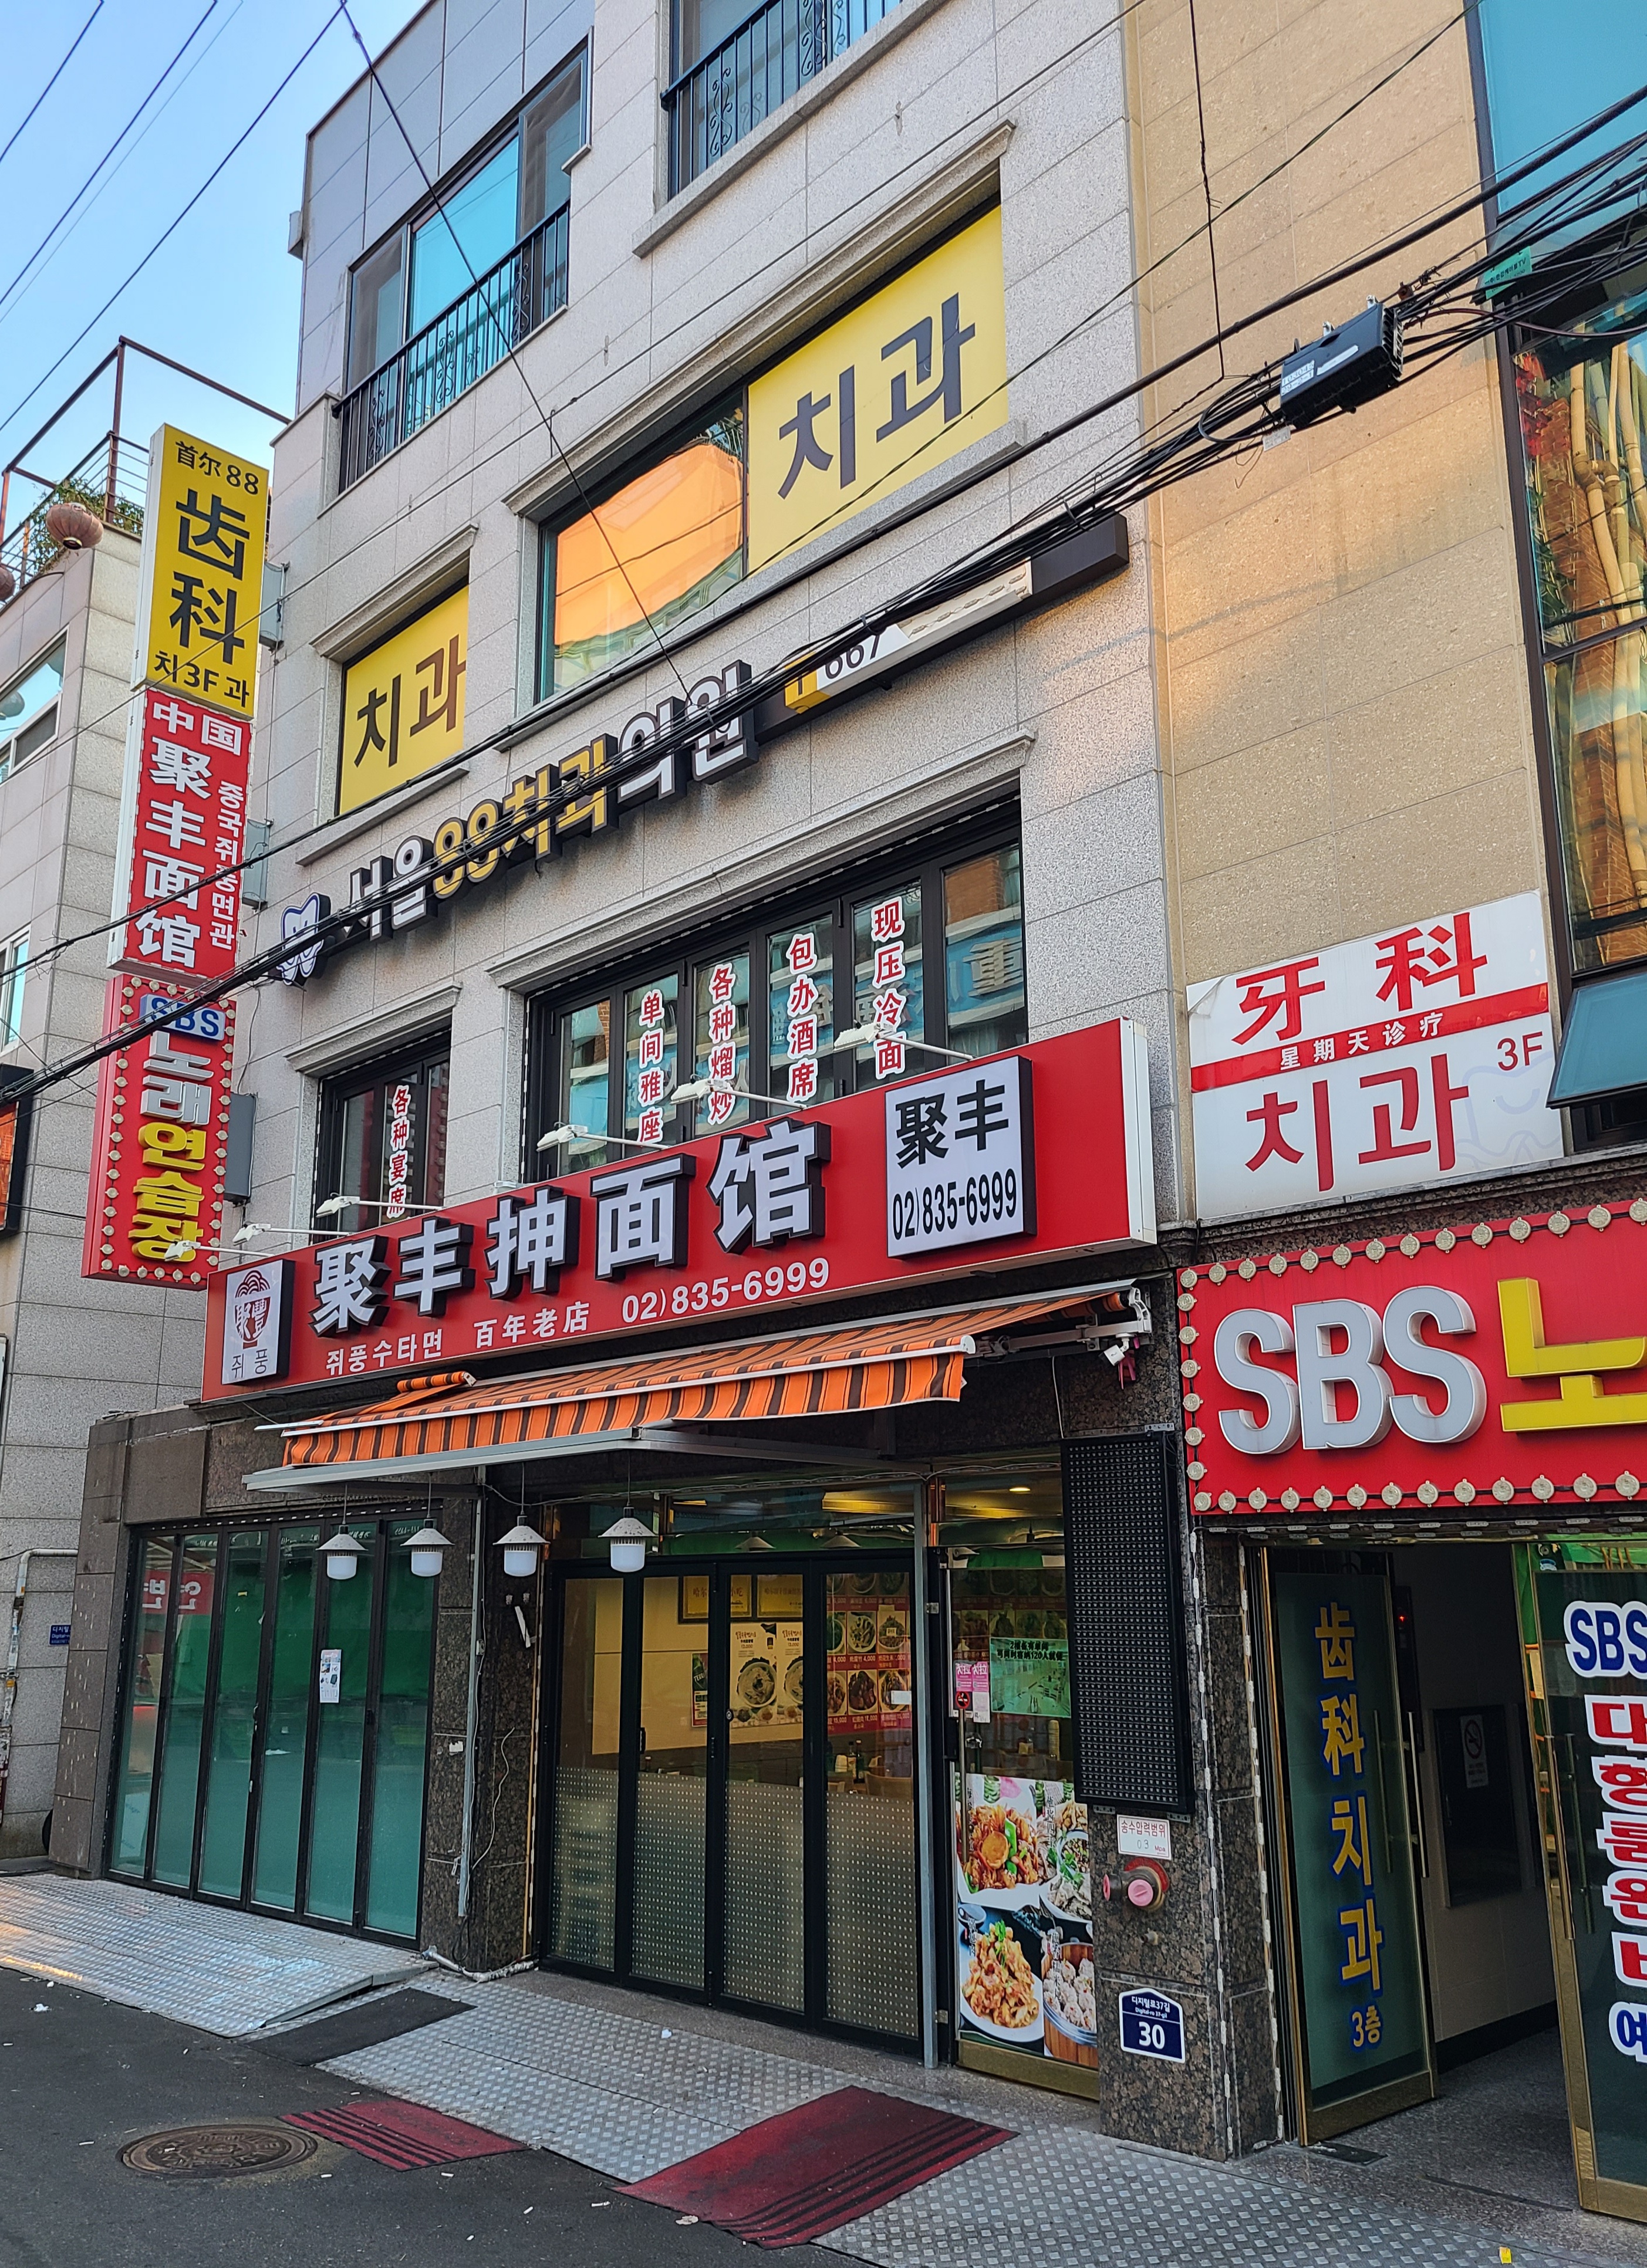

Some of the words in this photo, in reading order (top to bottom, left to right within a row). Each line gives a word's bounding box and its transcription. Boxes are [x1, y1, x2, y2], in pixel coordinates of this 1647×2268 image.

[778, 292, 976, 499] 치과
[169, 488, 251, 665] 齿科
[153, 702, 242, 756] 中国
[354, 634, 466, 768] 치과
[134, 736, 212, 969] 聚丰面馆
[789, 937, 815, 1098] 包办酒席
[873, 900, 905, 1075] 现压冷面
[1231, 911, 1488, 1045] 牙科
[1280, 1012, 1444, 1070] 星期天诊疗
[638, 992, 663, 1143] 单间雅座
[710, 966, 734, 1121] 各种熘炒
[1497, 1031, 1544, 1071] 3F
[129, 1030, 214, 1263] 노래연습장
[389, 1088, 410, 1214] 各种宴席
[895, 1079, 1010, 1169] 聚丰
[1244, 1053, 1469, 1192] 치과
[893, 1168, 1017, 1241] 02)835-6999
[326, 1328, 443, 1377] 쥐풍수타면
[473, 1300, 590, 1349] 百年老店
[622, 1257, 829, 1324] 02)835-6999
[1214, 1285, 1487, 1455] SBS
[1497, 1277, 1647, 1432] 노
[1315, 1601, 1365, 1776] 齿科
[1570, 1608, 1647, 1674] SBS
[1121, 1820, 1166, 1838] 송수압력범위
[1331, 1796, 1382, 1990] 치과
[1131, 1996, 1170, 2013] 디지털로37길
[1139, 2021, 1166, 2050] 30
[1352, 2005, 1381, 2047] 3층
